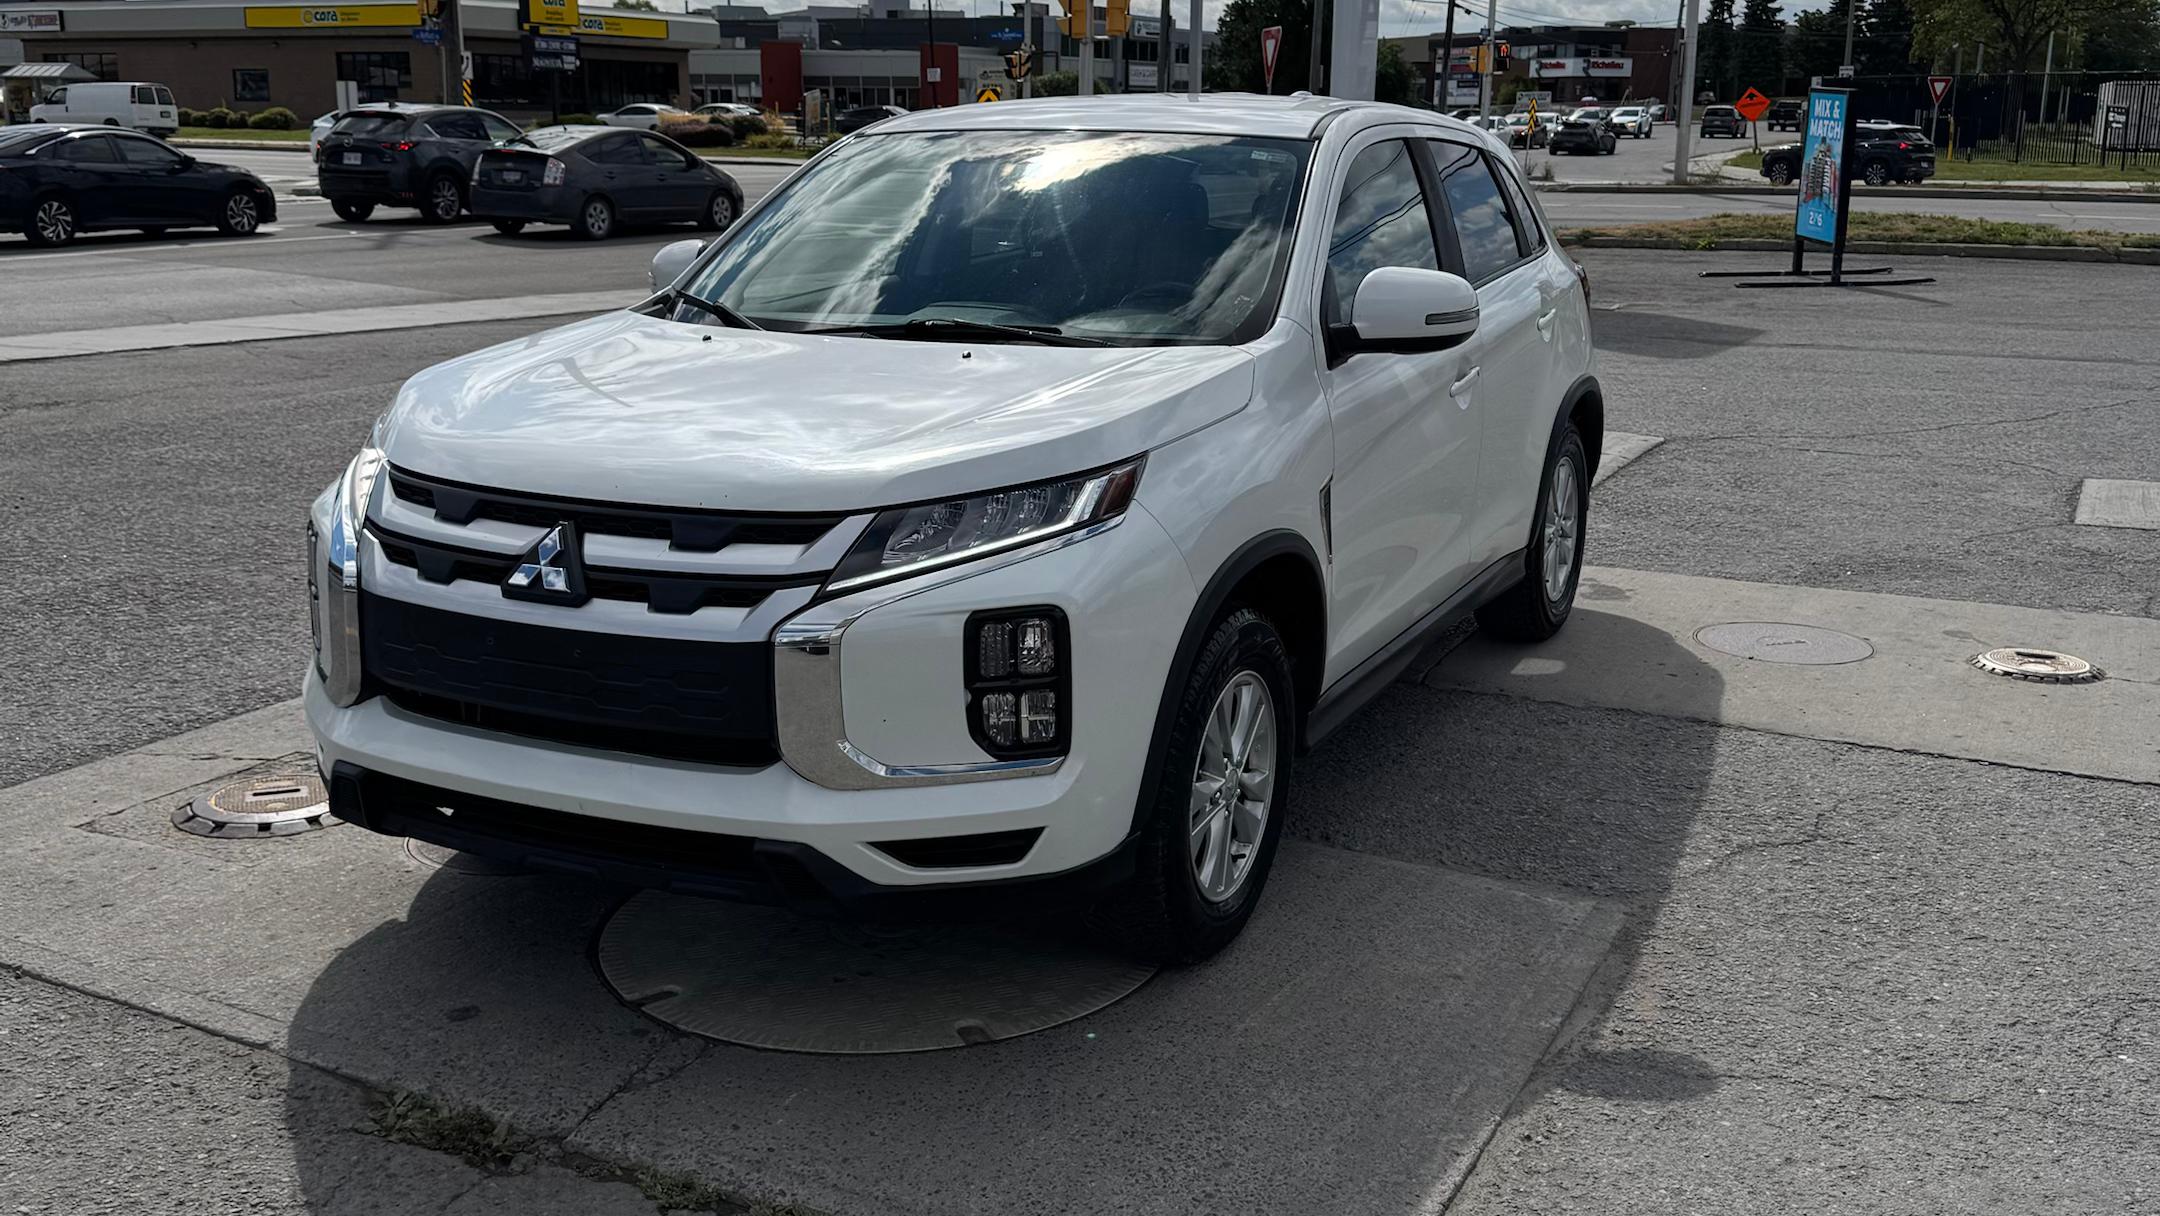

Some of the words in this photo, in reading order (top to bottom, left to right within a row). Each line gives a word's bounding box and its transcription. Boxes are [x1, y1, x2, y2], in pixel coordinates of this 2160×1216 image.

[314, 10, 338, 22] cora
[583, 19, 604, 30] cora
[1814, 98, 1831, 118] MIX
[1833, 100, 1841, 119] &
[1809, 118, 1842, 140] MATCH
